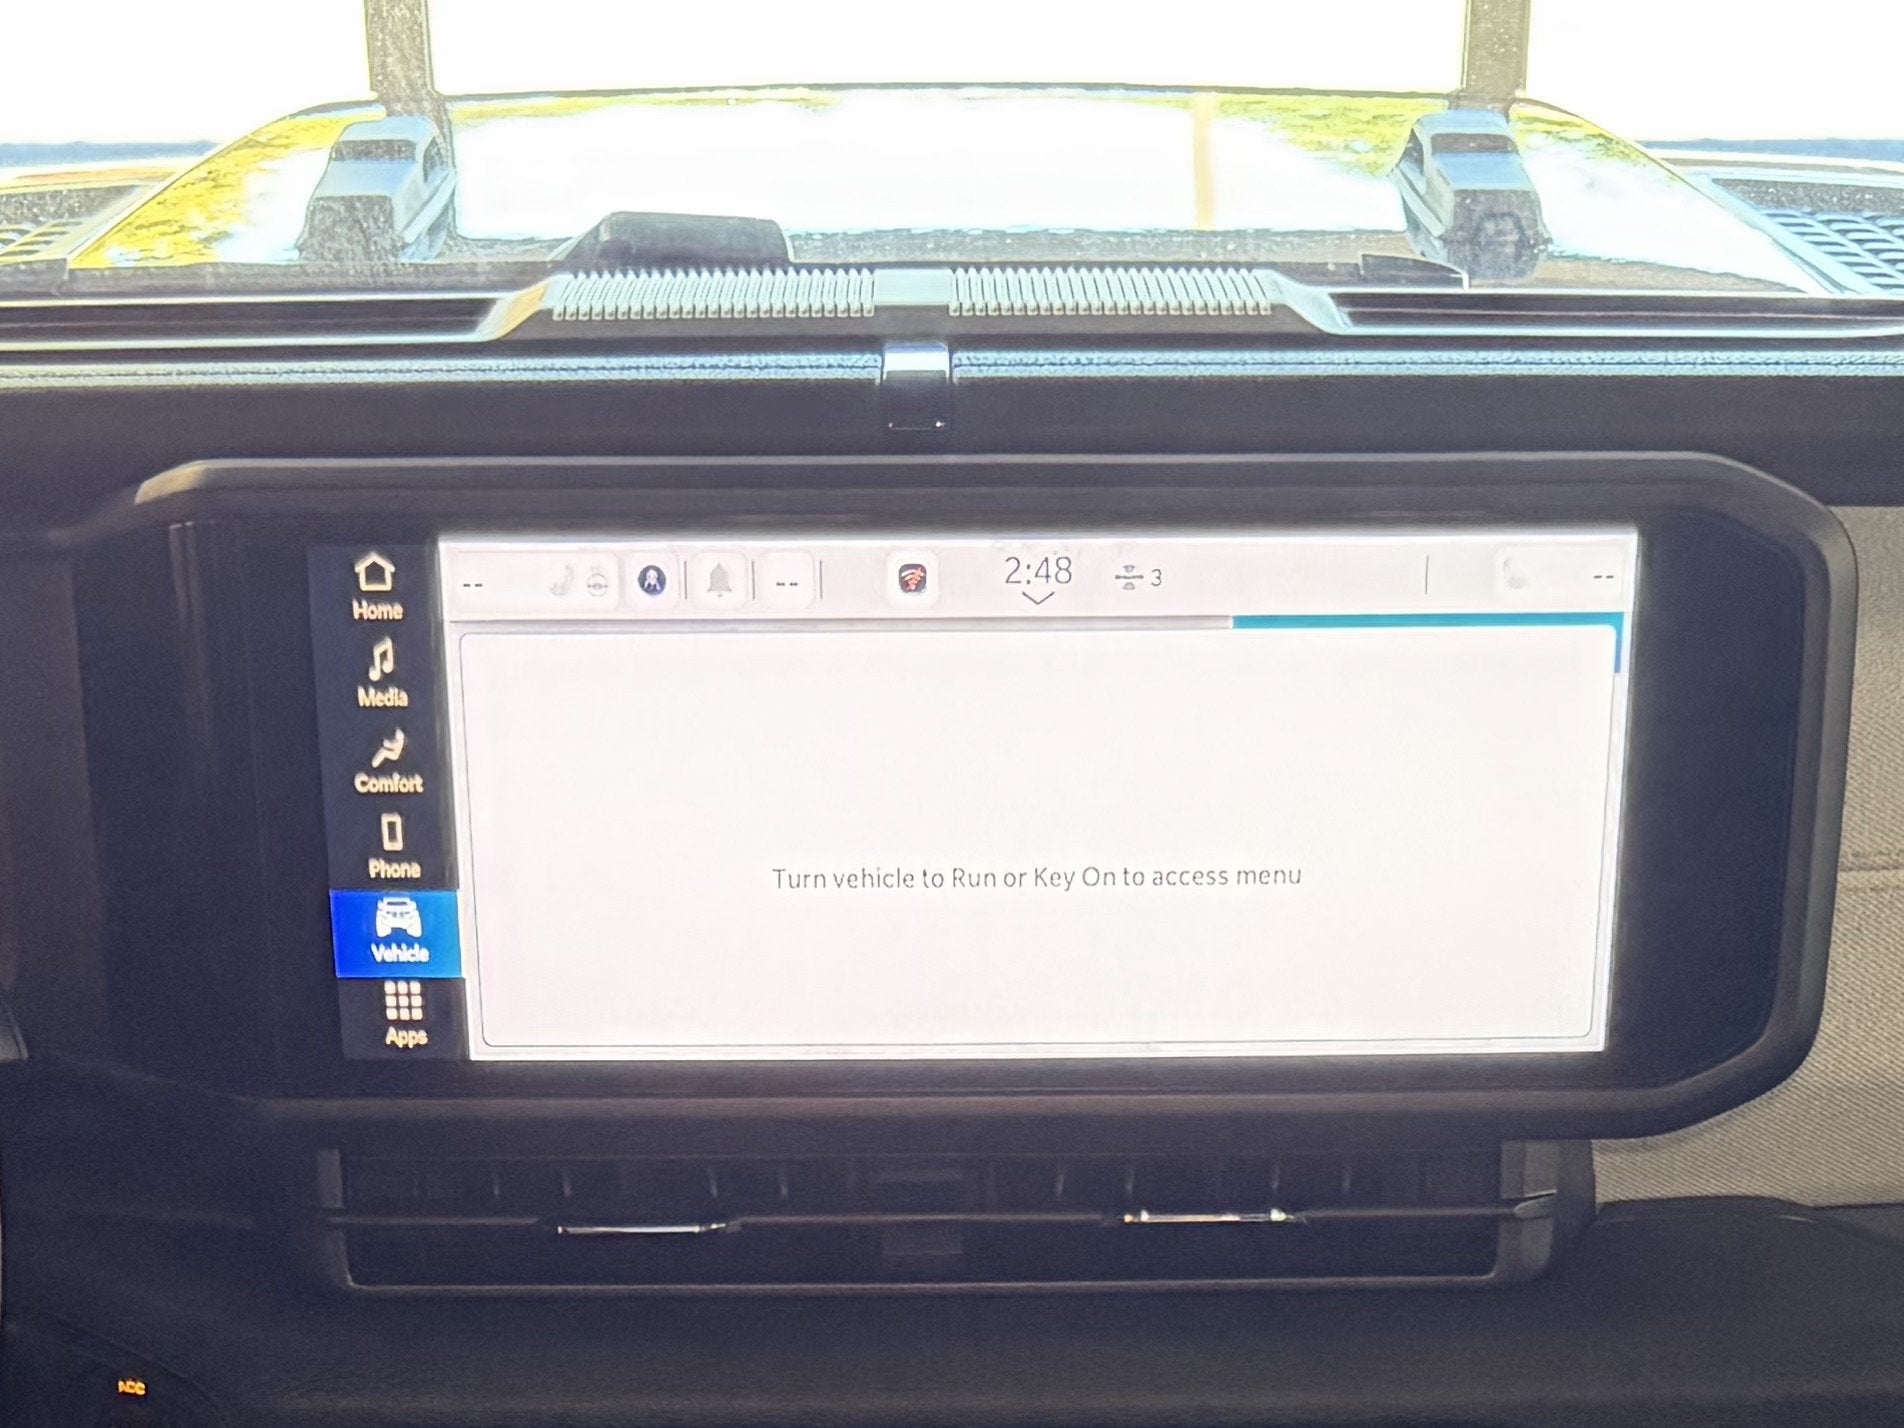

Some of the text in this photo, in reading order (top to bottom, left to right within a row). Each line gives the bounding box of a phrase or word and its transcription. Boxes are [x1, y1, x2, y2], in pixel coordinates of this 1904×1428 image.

[1005, 556, 1073, 586] 2:48
[352, 600, 404, 620] Home
[357, 686, 409, 707] Media
[354, 773, 424, 794] Comfort
[368, 857, 422, 879] Phone
[772, 866, 1302, 892] Turn vehicle to Run or Key On to access menu
[371, 944, 430, 963] Vehicle
[385, 1027, 428, 1049] Apps
[117, 1380, 146, 1396] ACC
